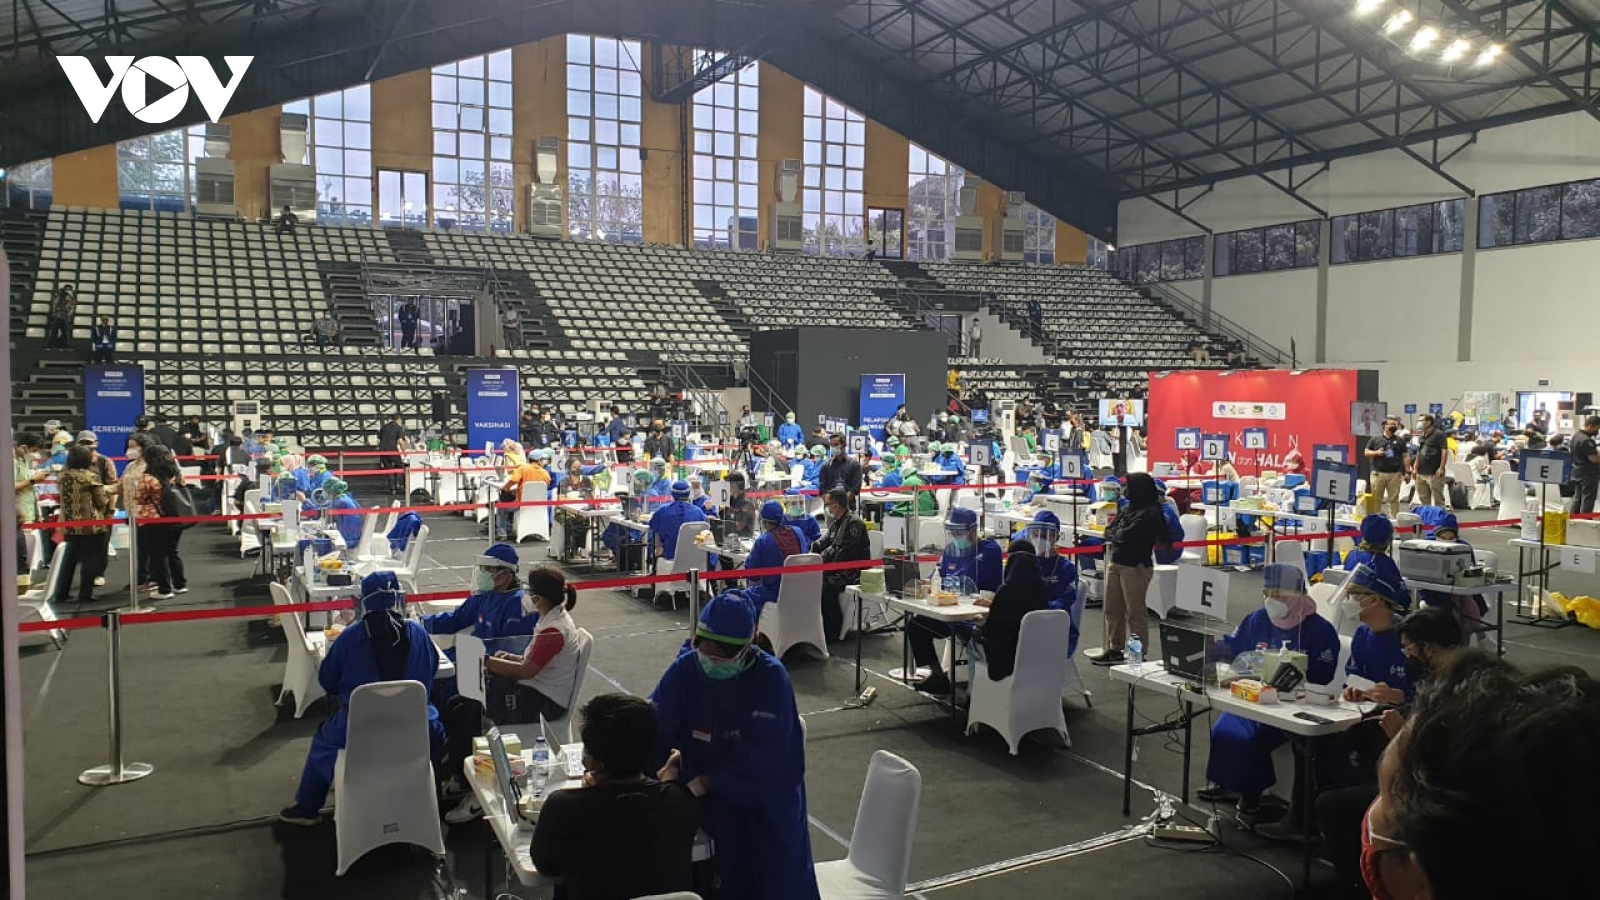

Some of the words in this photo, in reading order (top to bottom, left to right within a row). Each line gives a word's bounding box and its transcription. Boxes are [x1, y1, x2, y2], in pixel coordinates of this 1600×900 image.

[474, 421, 511, 429] VAKSINASI
[854, 438, 863, 451] C
[1183, 437, 1191, 446] C
[1252, 437, 1259, 446] D
[977, 450, 983, 459] D
[1209, 443, 1217, 456] D
[1068, 462, 1075, 474] D
[1540, 465, 1550, 479] E
[1329, 479, 1337, 495] E
[1310, 522, 1317, 531] D
[1573, 554, 1581, 565] E
[1201, 580, 1213, 608] E
